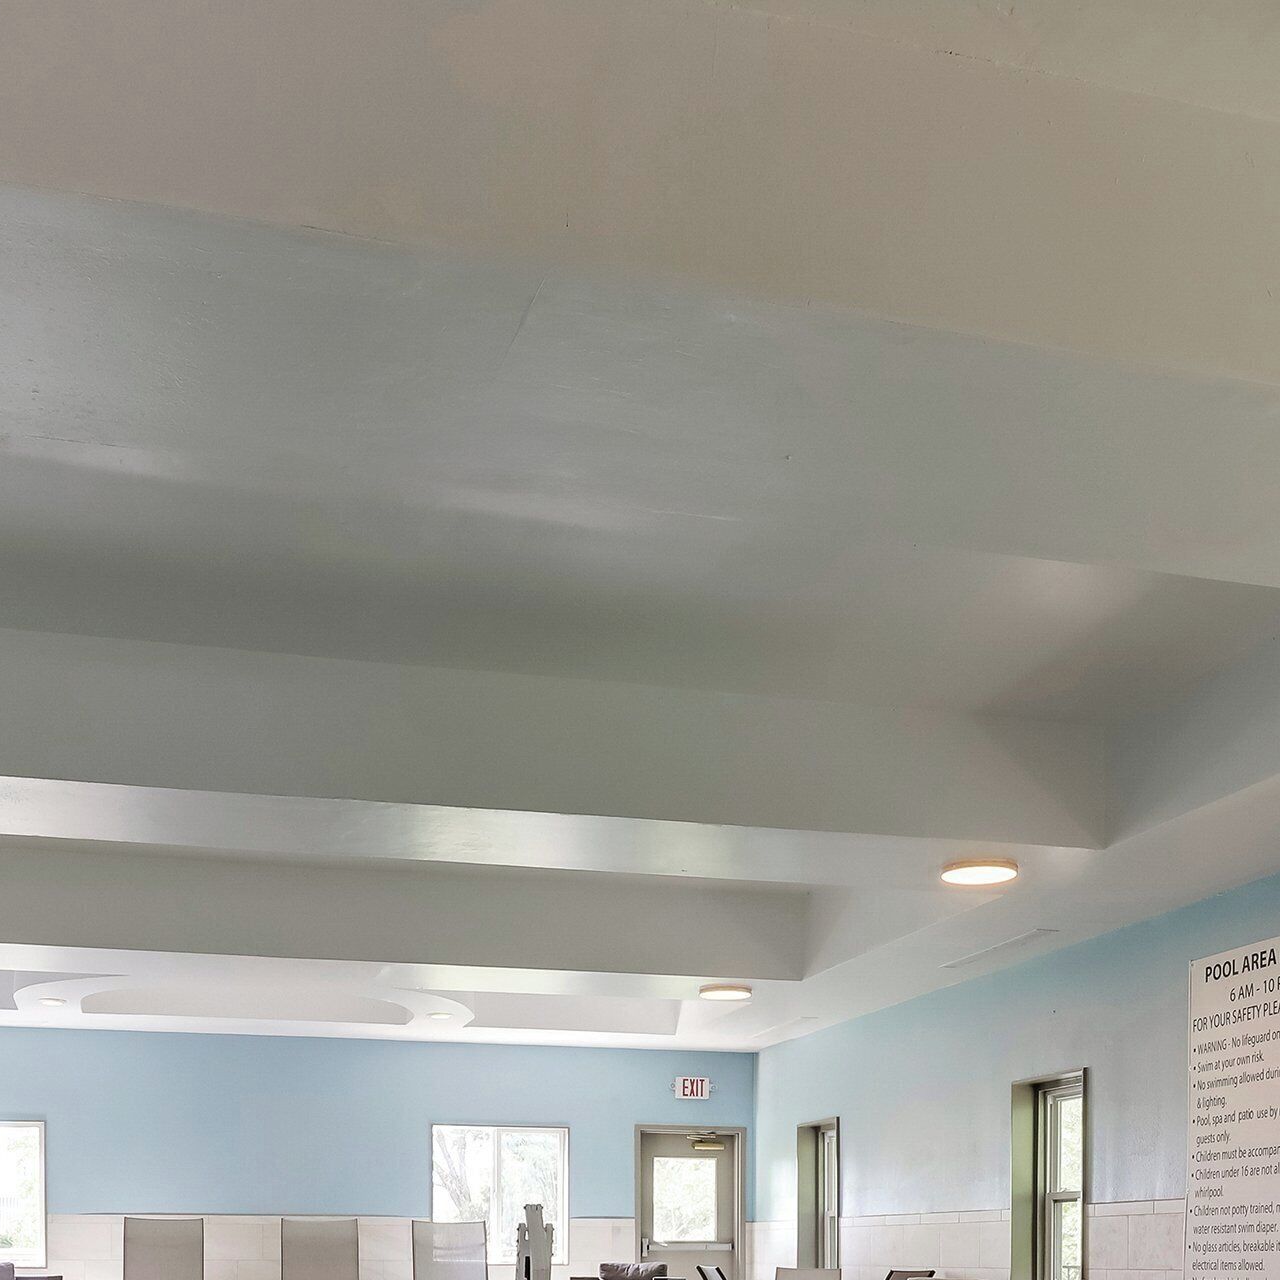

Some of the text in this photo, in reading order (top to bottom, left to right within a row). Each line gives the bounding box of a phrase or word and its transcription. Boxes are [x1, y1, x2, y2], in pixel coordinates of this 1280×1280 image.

[1205, 959, 1239, 983] POOL
[1241, 948, 1277, 974] AREA
[1229, 987, 1236, 1002] 6
[1238, 983, 1254, 1000] AM
[1263, 978, 1275, 994] 10
[1192, 1016, 1208, 1033] FOR
[1209, 1011, 1231, 1029] YOUR
[1232, 1003, 1262, 1024] SAFETY
[1197, 1038, 1227, 1055] WARNING
[1232, 1037, 1240, 1048] No
[1241, 1029, 1271, 1048] lifeguard
[1272, 1030, 1280, 1040] on
[1197, 1061, 1214, 1073] Swim
[1214, 1060, 1221, 1070] at
[1221, 1058, 1236, 1071] your
[1236, 1055, 1251, 1066] own
[682, 1078, 705, 1097] EXIT
[1197, 1080, 1206, 1091] No
[1207, 1075, 1238, 1088] swimming
[1239, 1068, 1264, 1084] allowed
[1196, 1097, 1201, 1109] &
[1212, 1114, 1222, 1127] spa
[1224, 1110, 1235, 1123] and
[1256, 1109, 1268, 1119] use
[1269, 1105, 1278, 1120] by
[1196, 1130, 1231, 1147] guests only.
[1196, 1150, 1220, 1162] Children
[1221, 1149, 1237, 1160] must
[1239, 1146, 1246, 1158] be
[1195, 1168, 1220, 1180] Children
[1221, 1166, 1239, 1178] under
[1241, 1165, 1248, 1176] 16
[1250, 1167, 1260, 1176] are
[1261, 1165, 1273, 1175] not
[1194, 1205, 1218, 1216] Children
[1220, 1206, 1230, 1215] not
[1232, 1204, 1248, 1217] potty
[1193, 1221, 1278, 1235] water resistant swim diaper.
[1193, 1241, 1201, 1252] No
[1202, 1241, 1217, 1255] glass
[1243, 1240, 1274, 1252] breakable
[1192, 1258, 1265, 1271] electrical items allowed.
